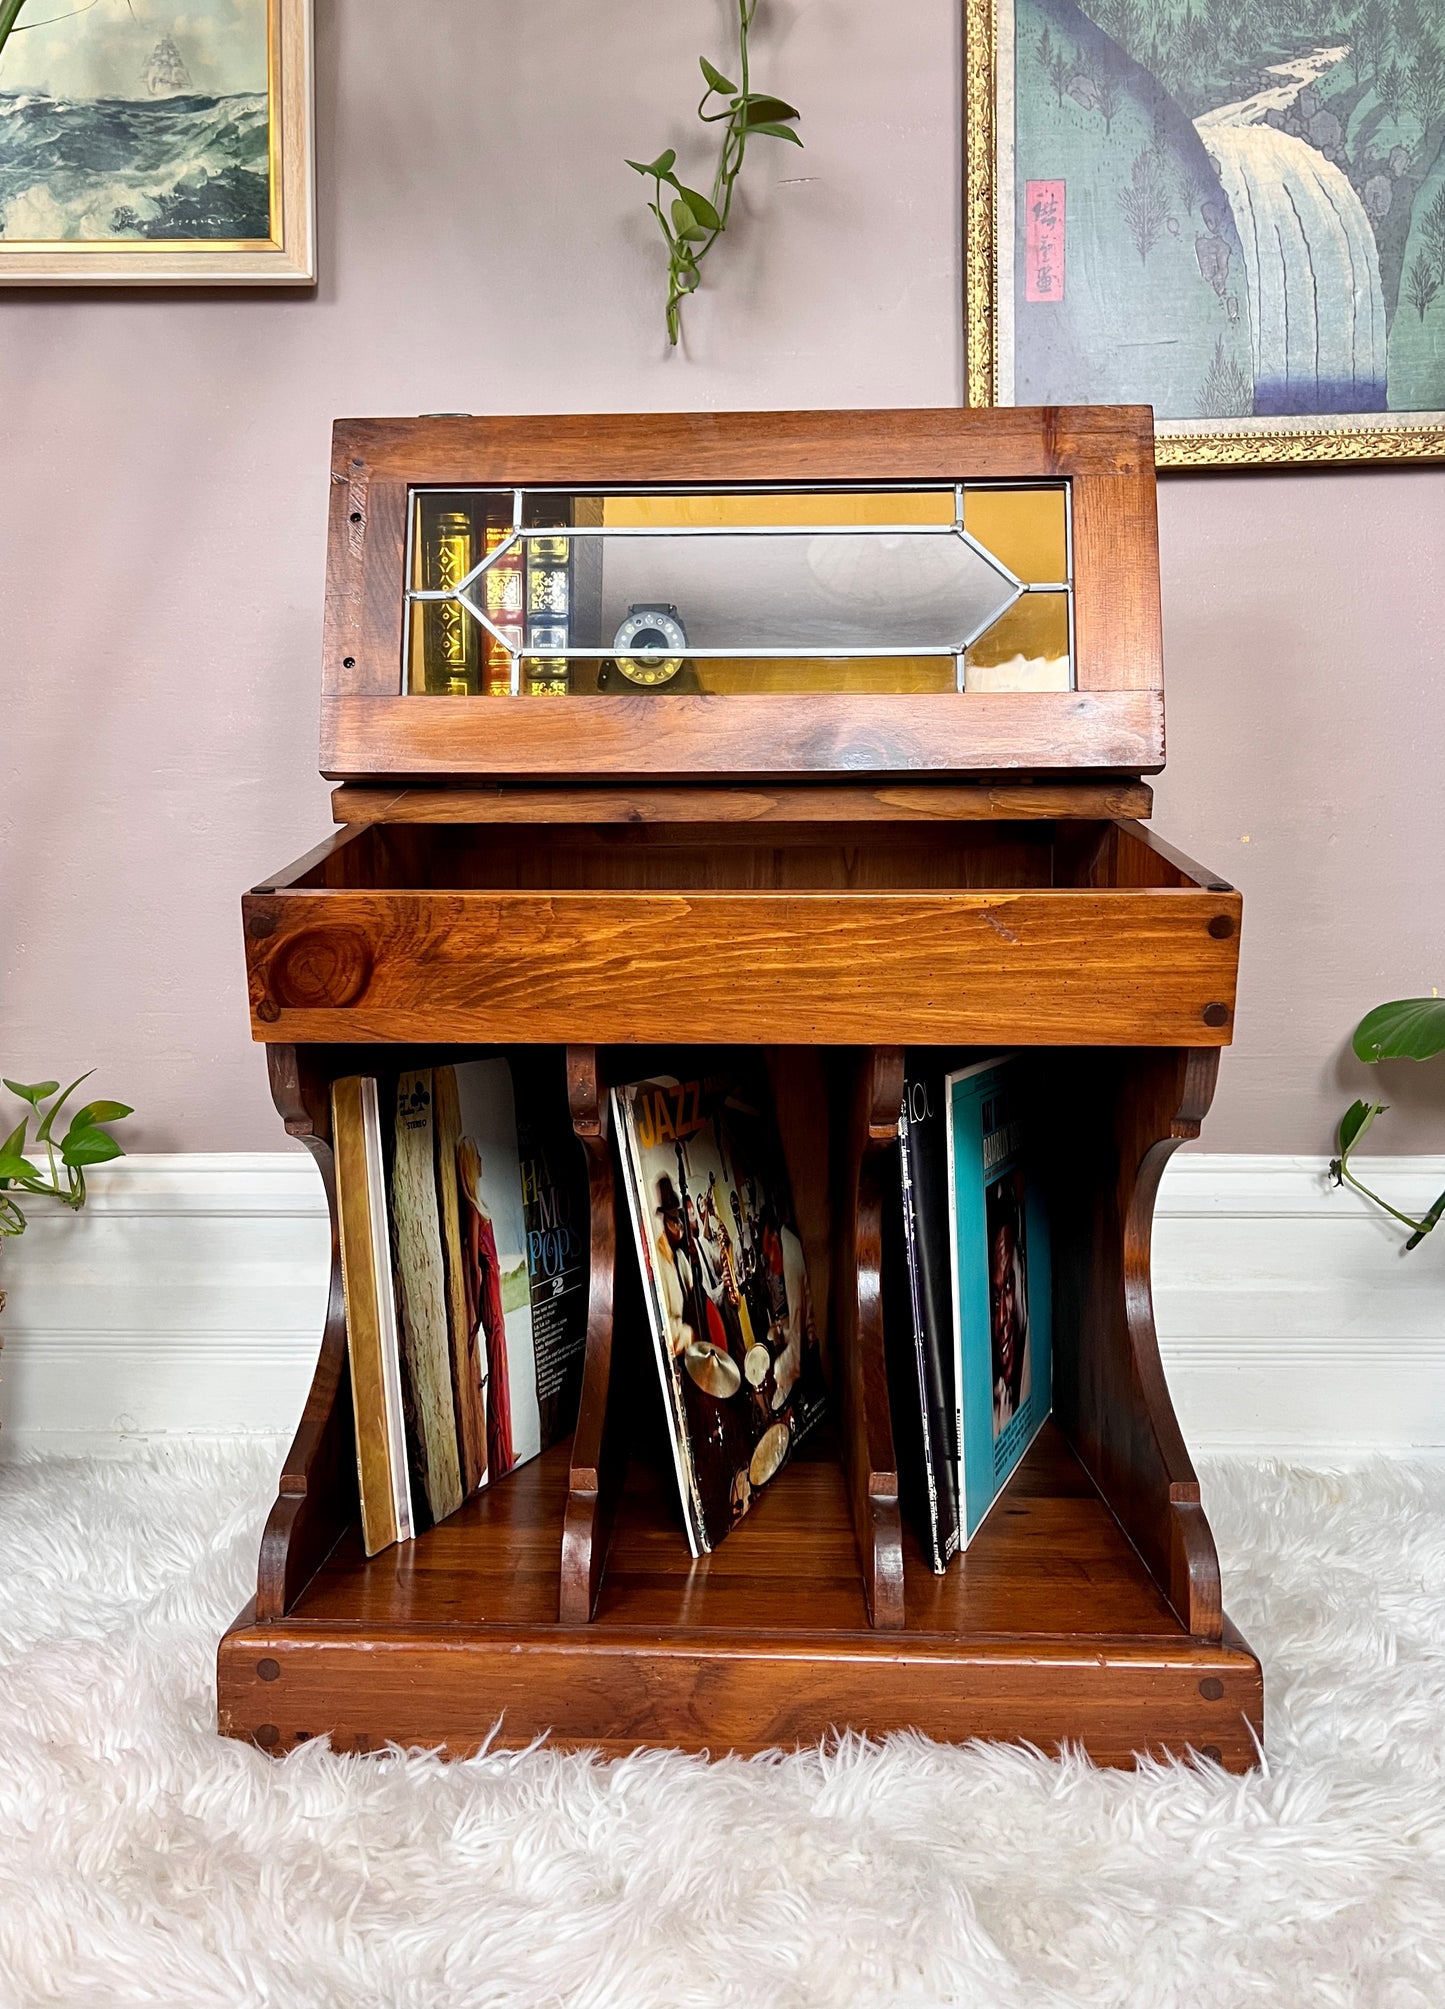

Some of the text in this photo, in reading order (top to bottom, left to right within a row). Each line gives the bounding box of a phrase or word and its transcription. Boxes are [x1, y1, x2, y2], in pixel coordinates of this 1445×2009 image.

[639, 1080, 705, 1149] JAZZ
[908, 1082, 933, 1123] LOU
[406, 1119, 427, 1130] STEREO
[528, 1226, 583, 1276] POPS
[552, 1276, 565, 1296] 2
